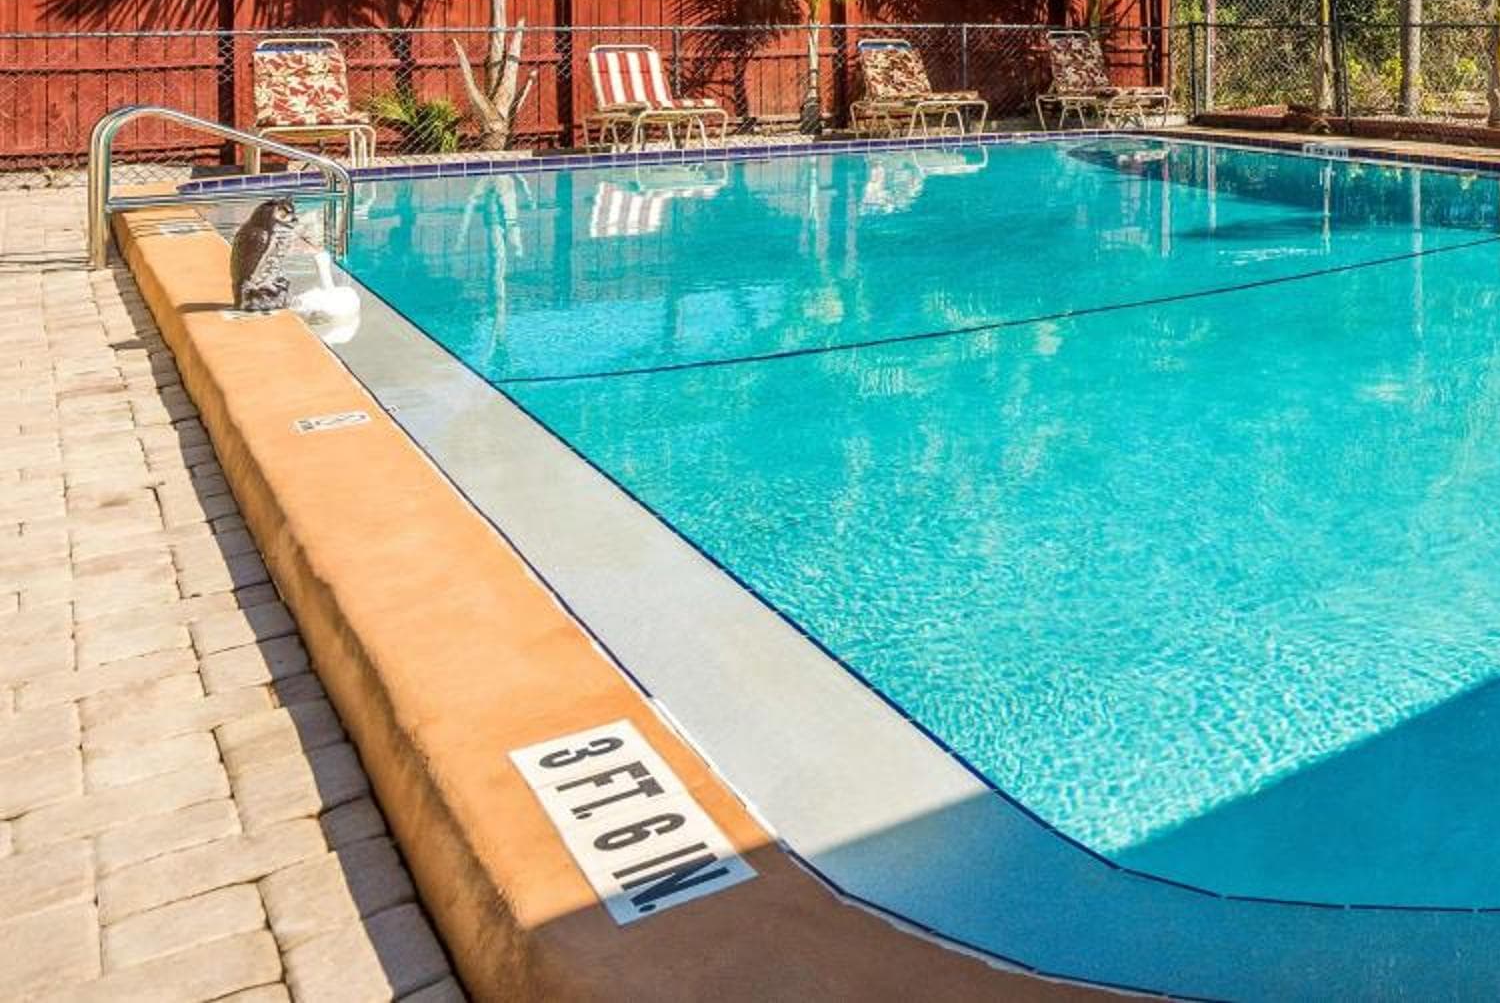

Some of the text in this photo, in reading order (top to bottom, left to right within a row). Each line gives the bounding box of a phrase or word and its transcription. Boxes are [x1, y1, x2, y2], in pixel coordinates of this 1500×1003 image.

[539, 737, 731, 913] 3 FT. 6 IN.
